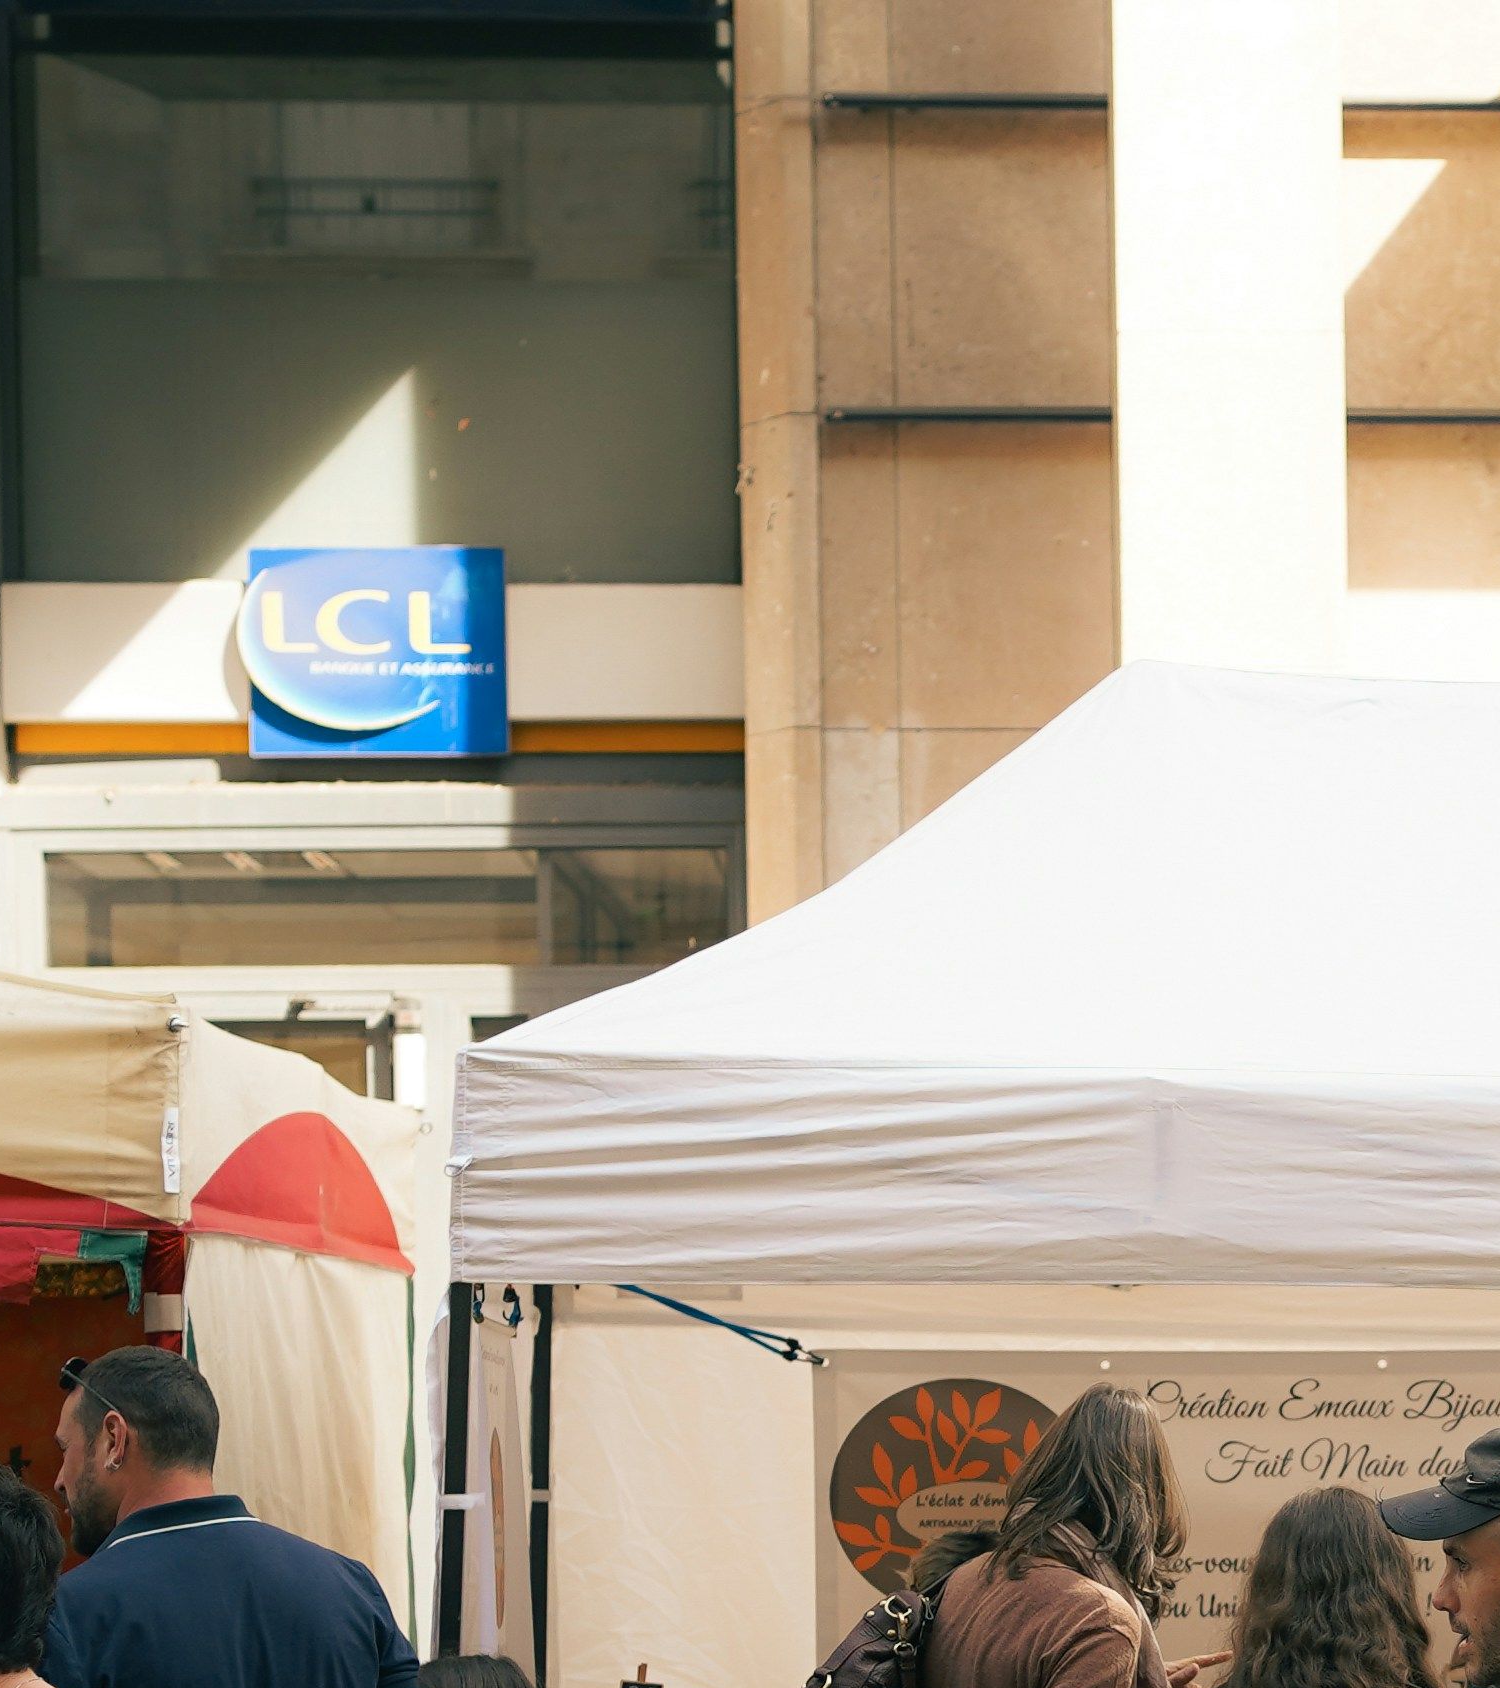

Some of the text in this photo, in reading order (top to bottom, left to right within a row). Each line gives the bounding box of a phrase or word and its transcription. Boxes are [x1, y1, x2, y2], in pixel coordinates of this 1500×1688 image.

[261, 589, 472, 655] LCL
[1147, 1378, 1268, 1424] Création
[1278, 1378, 1394, 1422] Emaux
[1205, 1440, 1295, 1484] Fait
[1301, 1437, 1407, 1482] Main
